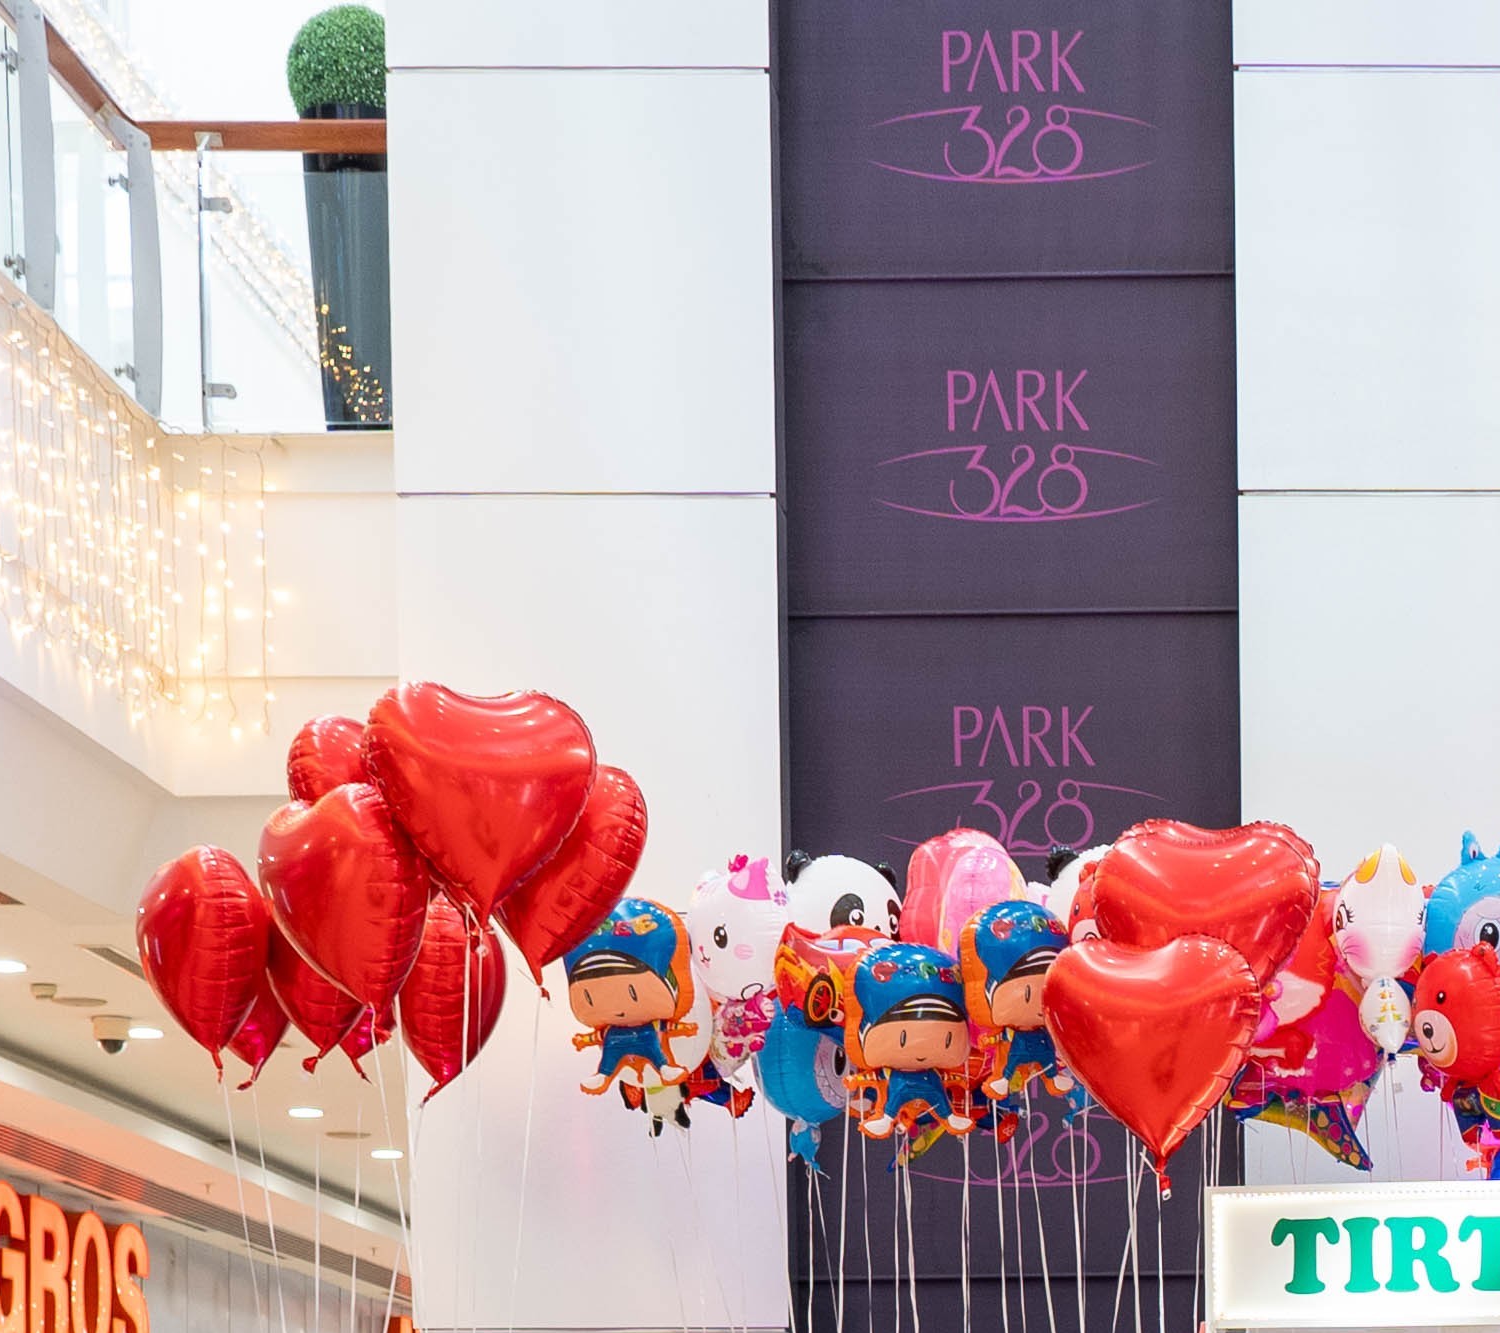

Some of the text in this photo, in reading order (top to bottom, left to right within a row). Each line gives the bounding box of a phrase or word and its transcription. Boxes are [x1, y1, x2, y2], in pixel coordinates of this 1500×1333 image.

[940, 31, 1085, 94] PARK
[944, 105, 1085, 182] 328
[947, 370, 1090, 433] PARK
[950, 444, 1090, 519] 328
[954, 707, 1097, 769] PARK
[956, 781, 1095, 857] 328
